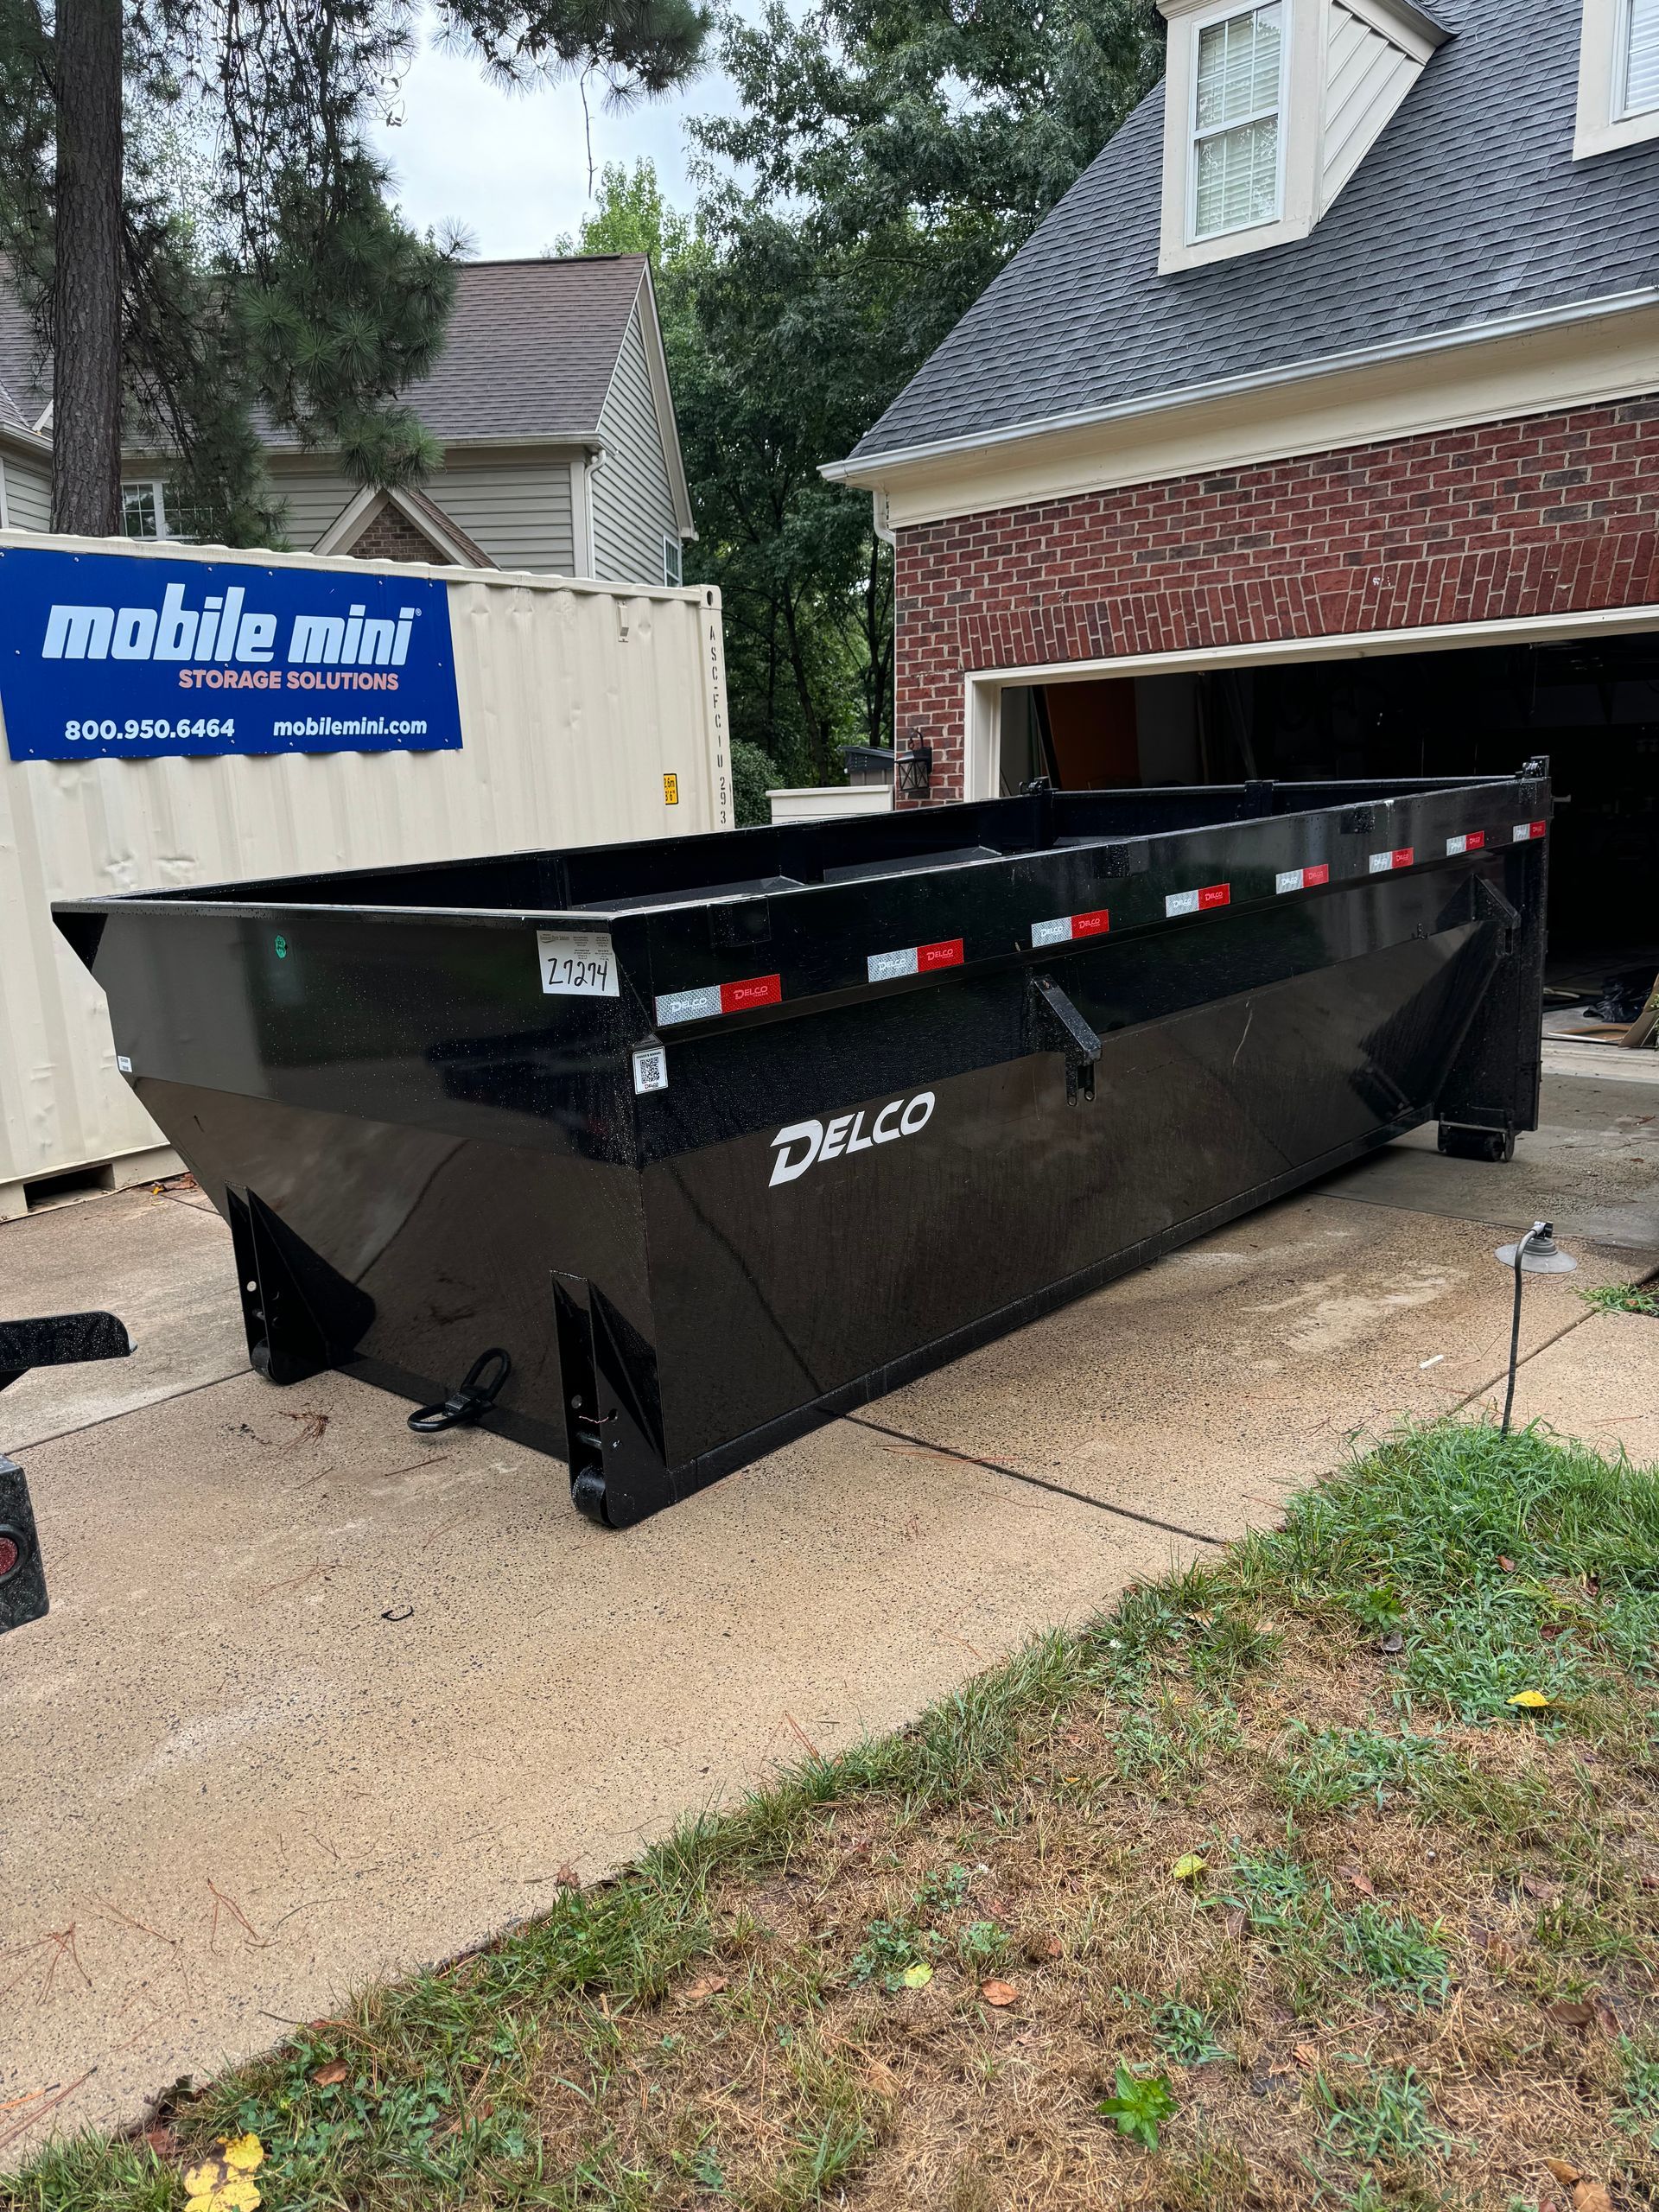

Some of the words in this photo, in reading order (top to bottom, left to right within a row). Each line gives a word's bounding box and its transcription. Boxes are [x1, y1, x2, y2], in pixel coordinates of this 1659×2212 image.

[41, 582, 277, 663] mobile
[287, 604, 416, 665] mini
[178, 669, 282, 689] STORAGE
[286, 671, 399, 690] SOLUTIONS
[65, 718, 235, 741] 800.950.6464
[273, 717, 427, 736] mobilemini.com
[877, 958, 906, 971] DELCO
[926, 949, 953, 961] DELCO
[669, 997, 707, 1013] DELCO
[734, 985, 768, 1000] DELCO
[768, 1091, 936, 1187] DELCO
